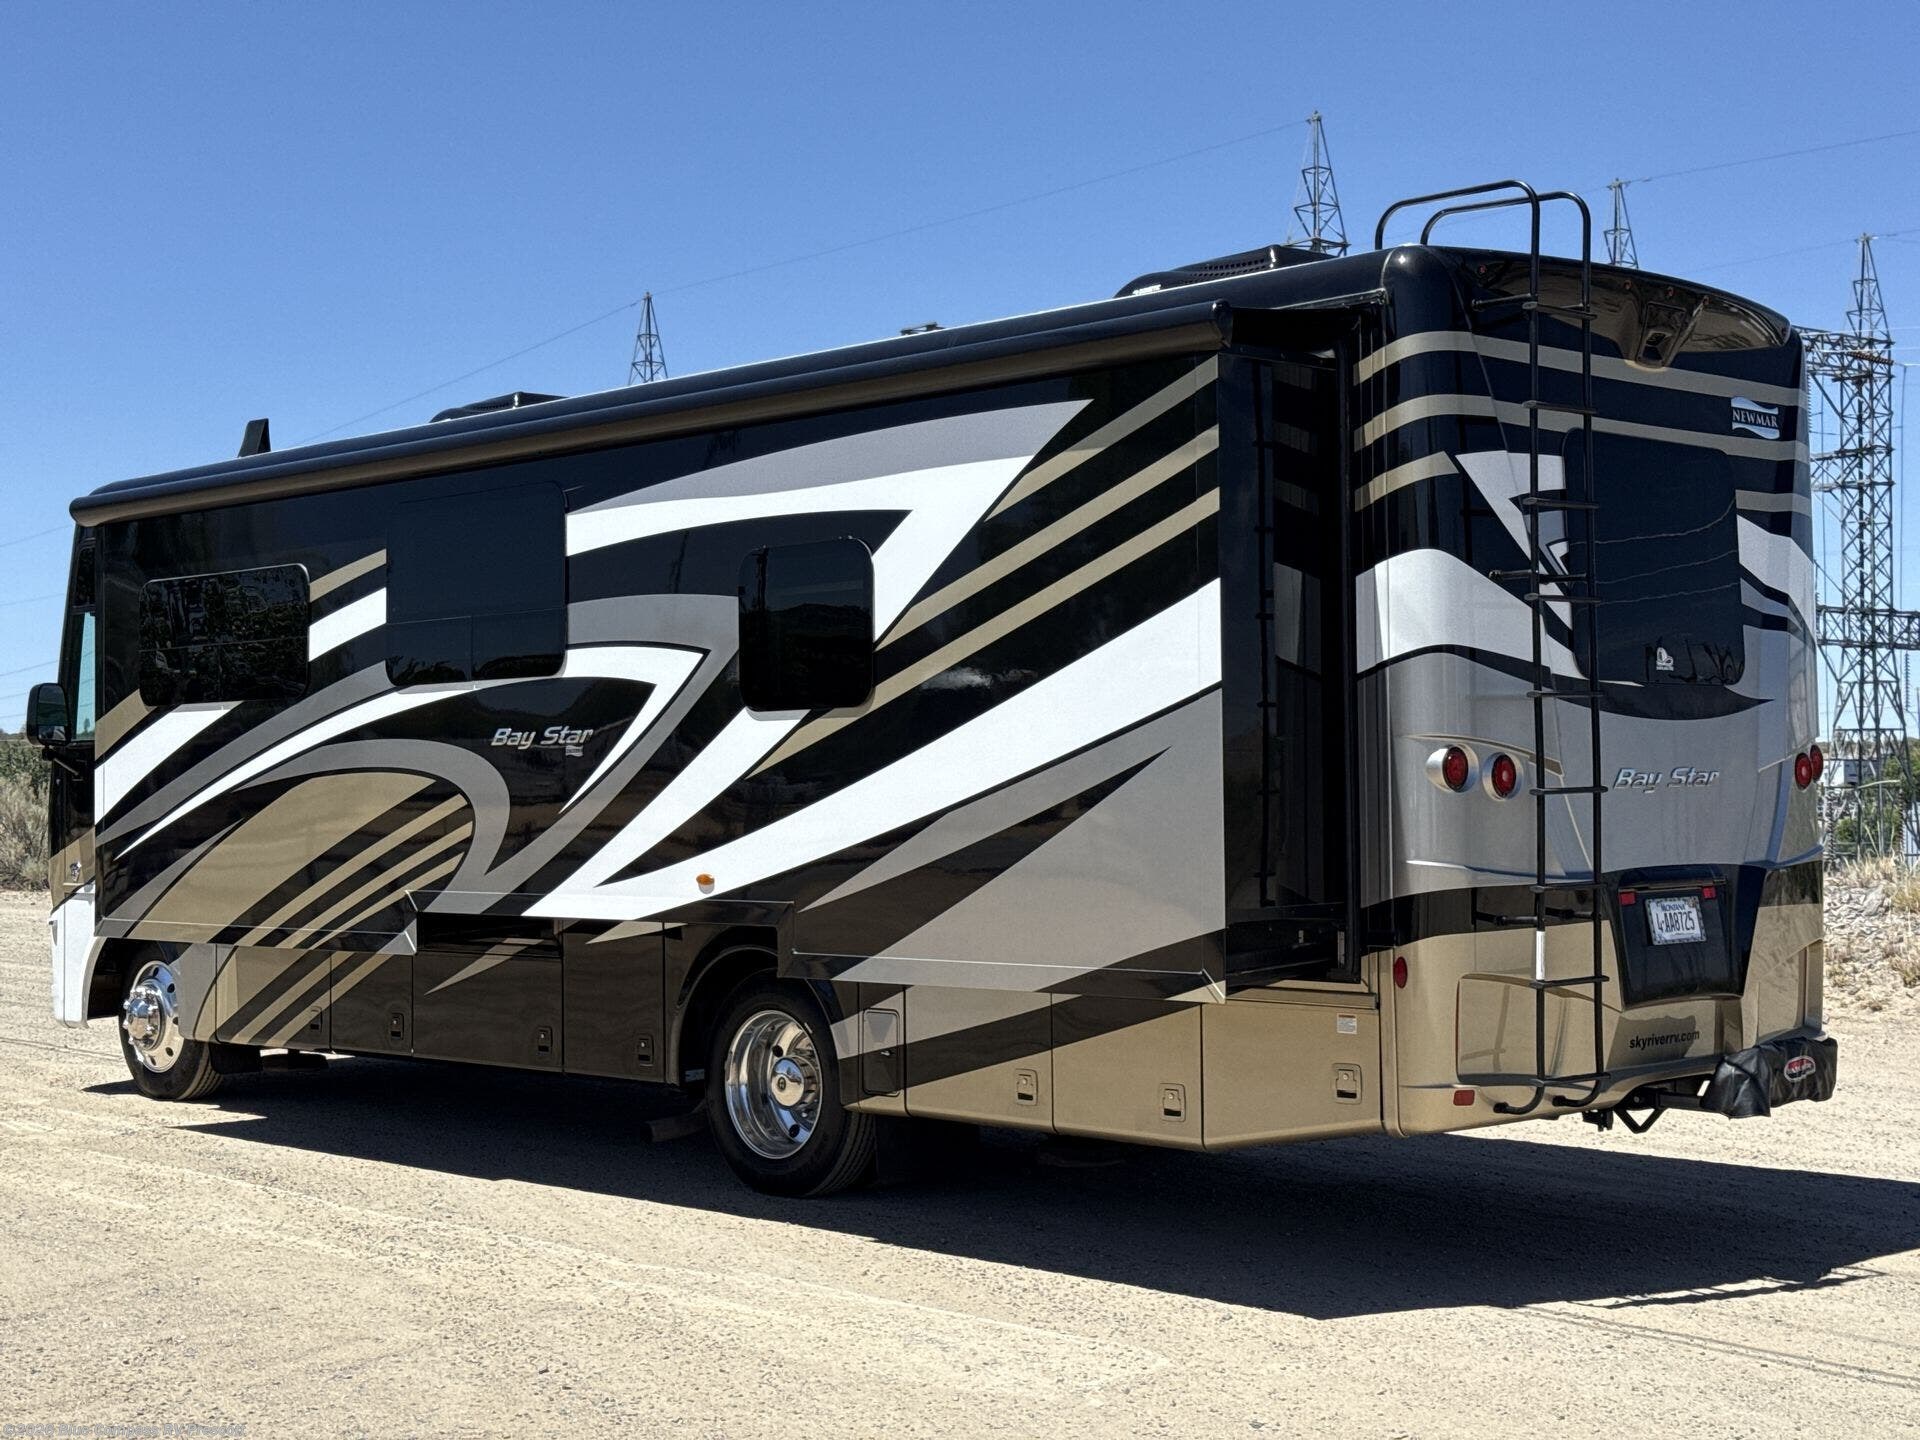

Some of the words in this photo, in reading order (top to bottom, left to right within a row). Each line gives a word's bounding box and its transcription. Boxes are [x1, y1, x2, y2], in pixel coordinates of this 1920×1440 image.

[1732, 409, 1778, 427] NEWMAR
[491, 727, 536, 750] Bay
[540, 725, 594, 745] Star
[1613, 767, 1662, 794] Bay
[1667, 766, 1720, 788] Star
[1629, 1031, 1700, 1050] skyriverrv.com
